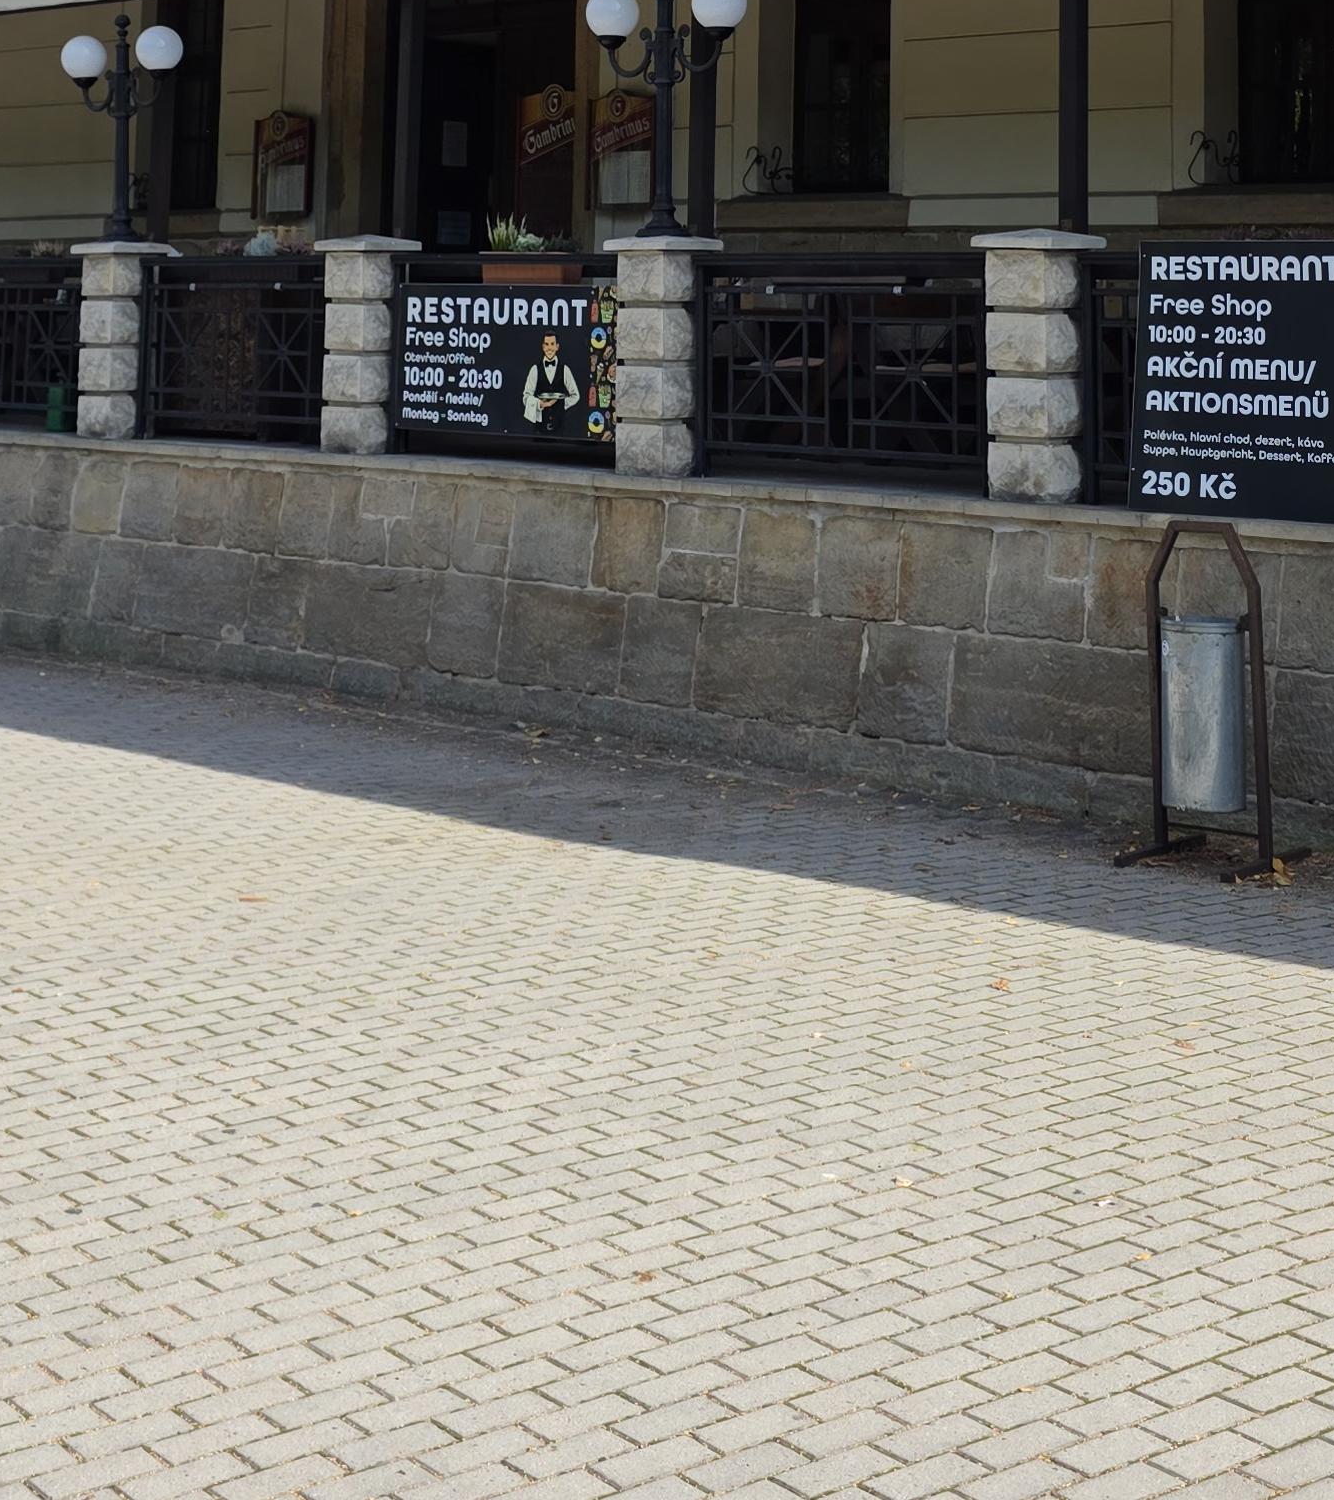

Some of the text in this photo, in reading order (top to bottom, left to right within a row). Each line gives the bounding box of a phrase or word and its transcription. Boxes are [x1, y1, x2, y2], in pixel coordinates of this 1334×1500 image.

[595, 117, 650, 152] Gambrinus
[406, 297, 587, 327] RESTAURANT
[1149, 293, 1272, 321] Free Shop
[405, 327, 491, 353] Free Shop
[1148, 325, 1196, 344] 10:00
[1214, 326, 1266, 346] 20:30
[404, 366, 444, 387] 10:00
[458, 369, 503, 390] 20:30
[1147, 350, 1316, 385] AKČNÍ MENU/
[403, 390, 437, 404] Pondělí
[1145, 389, 1329, 419] AKTIONSMENÜ
[402, 407, 439, 424] Montag
[447, 410, 488, 427] Sonntag
[1143, 429, 1324, 449] Polévka, hlavní chod, dezert, káva
[1143, 444, 1178, 459] Suppe,
[1181, 446, 1256, 461] Hauptgericht,
[1258, 449, 1305, 464] Dessert,
[1141, 470, 1237, 500] 250 Kč
